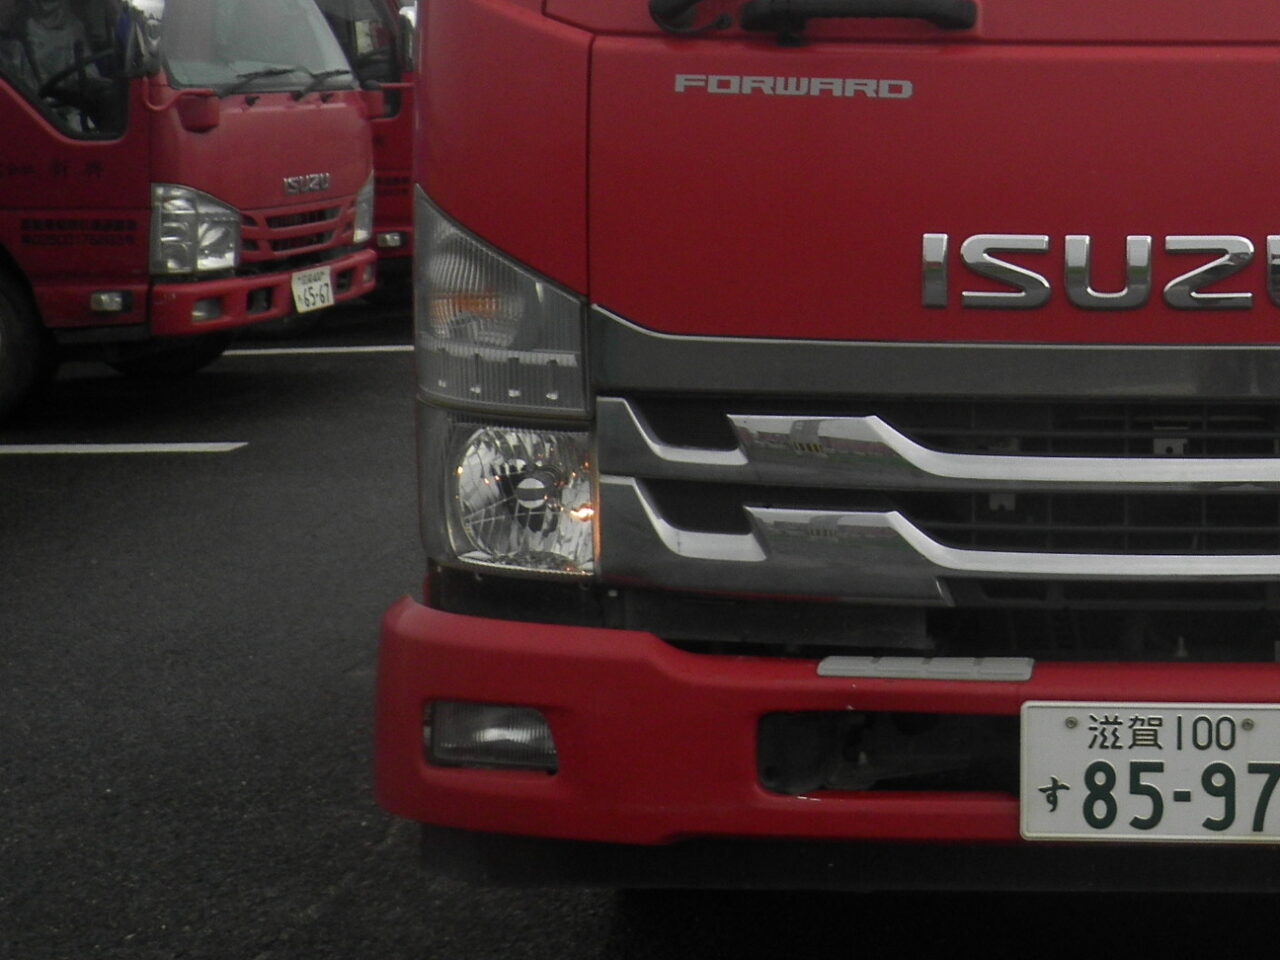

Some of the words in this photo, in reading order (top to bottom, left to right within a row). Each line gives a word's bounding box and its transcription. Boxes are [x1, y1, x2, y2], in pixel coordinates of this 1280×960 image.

[674, 73, 914, 99] FORWARD
[282, 172, 331, 194] ISUZU
[303, 282, 330, 308] 65-67
[1087, 713, 1164, 750] 滋賀
[1176, 715, 1236, 751] 100
[1037, 775, 1071, 813] す
